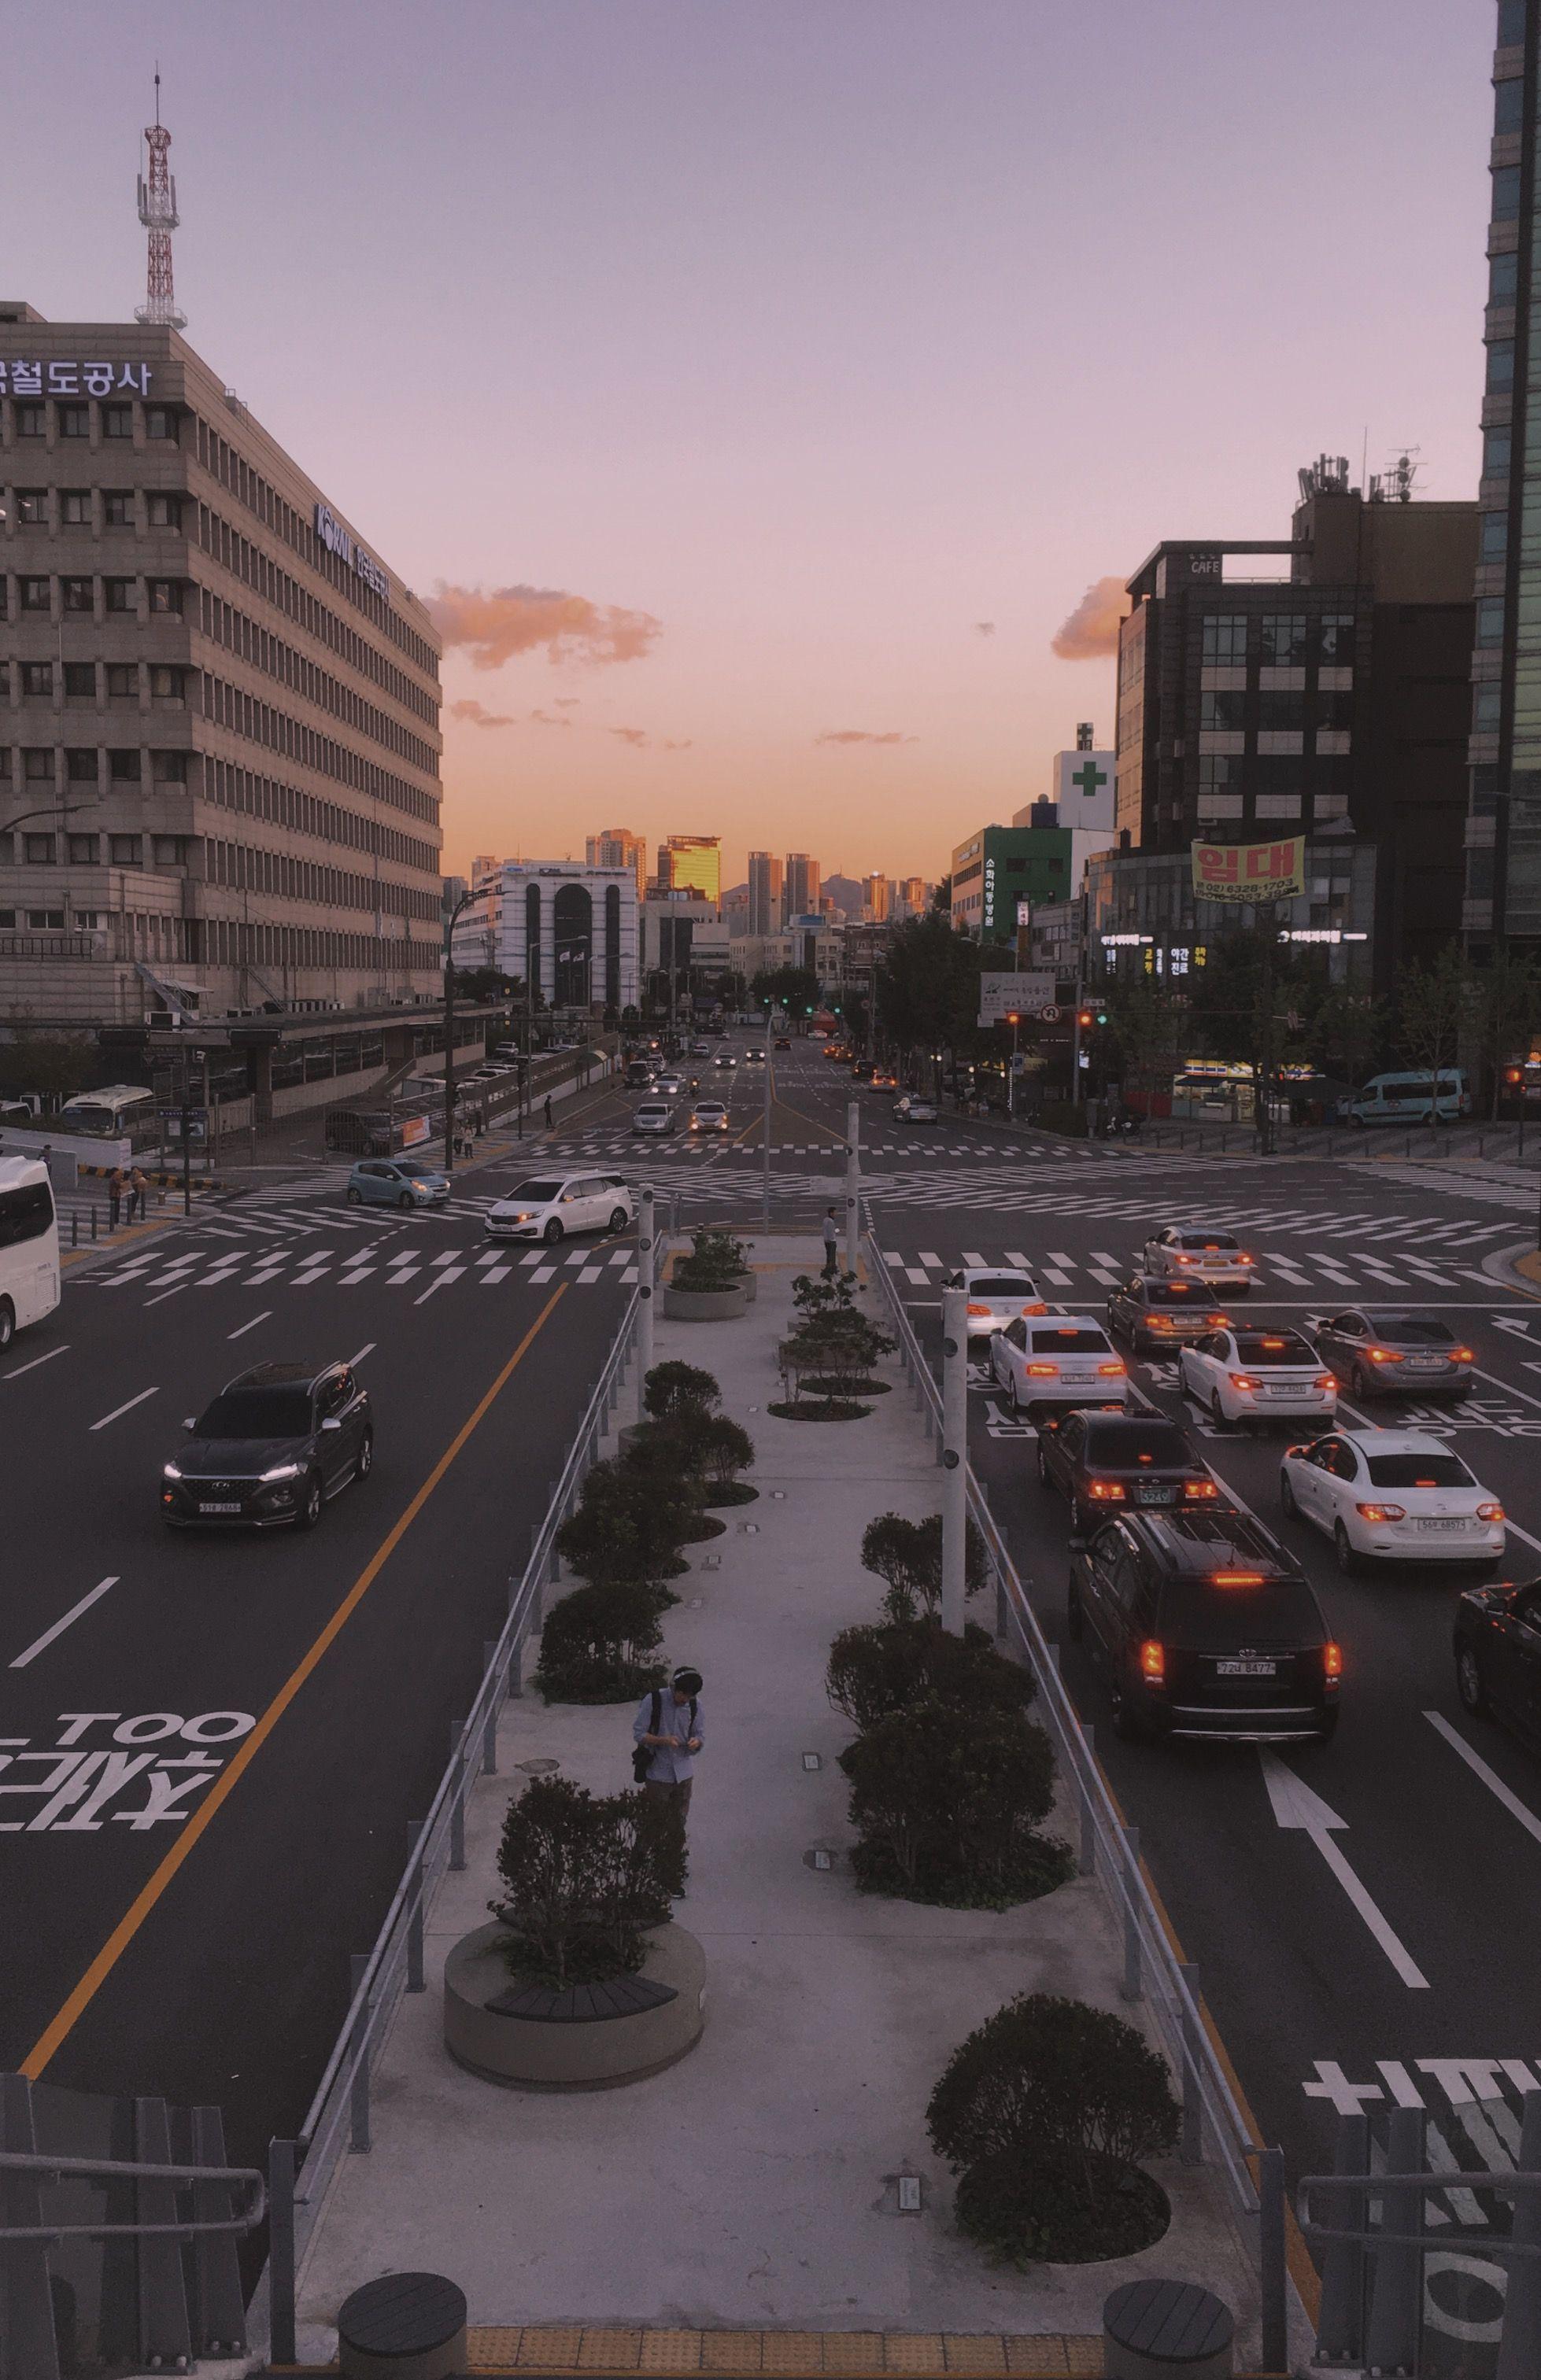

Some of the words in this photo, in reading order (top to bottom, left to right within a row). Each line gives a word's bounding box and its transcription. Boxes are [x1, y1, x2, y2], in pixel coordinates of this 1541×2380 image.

[0, 360, 152, 397] 철도공사
[1192, 561, 1218, 573] CAFE
[1197, 843, 1294, 883] 임대
[985, 858, 995, 927] 소화아동병원
[1171, 949, 1189, 961] 야간
[1171, 963, 1189, 976] 진료
[1246, 1663, 1271, 1673] 8477
